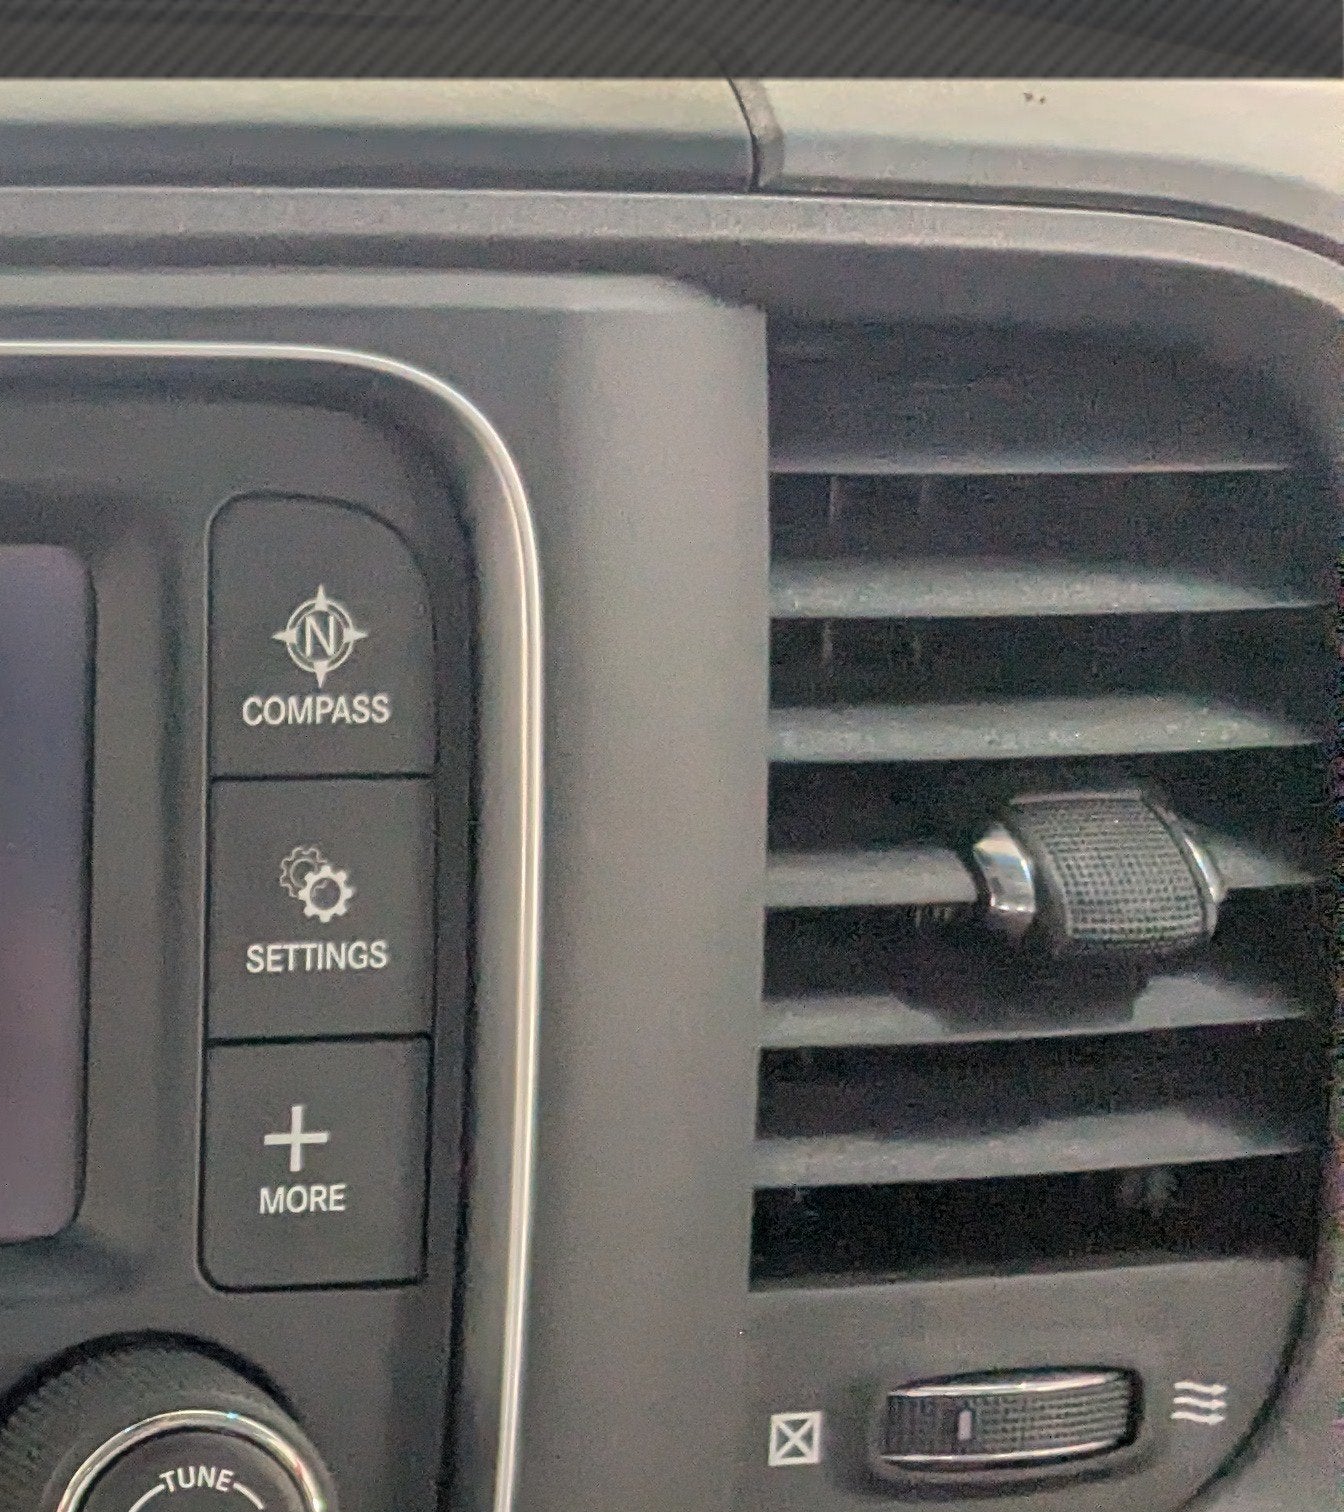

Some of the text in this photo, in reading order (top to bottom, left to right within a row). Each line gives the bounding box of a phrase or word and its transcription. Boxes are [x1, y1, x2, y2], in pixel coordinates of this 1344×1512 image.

[241, 693, 391, 727] COMPASS
[245, 940, 389, 975] SETTINGS
[258, 1183, 347, 1215] MORE
[159, 1463, 236, 1494] TUNE
